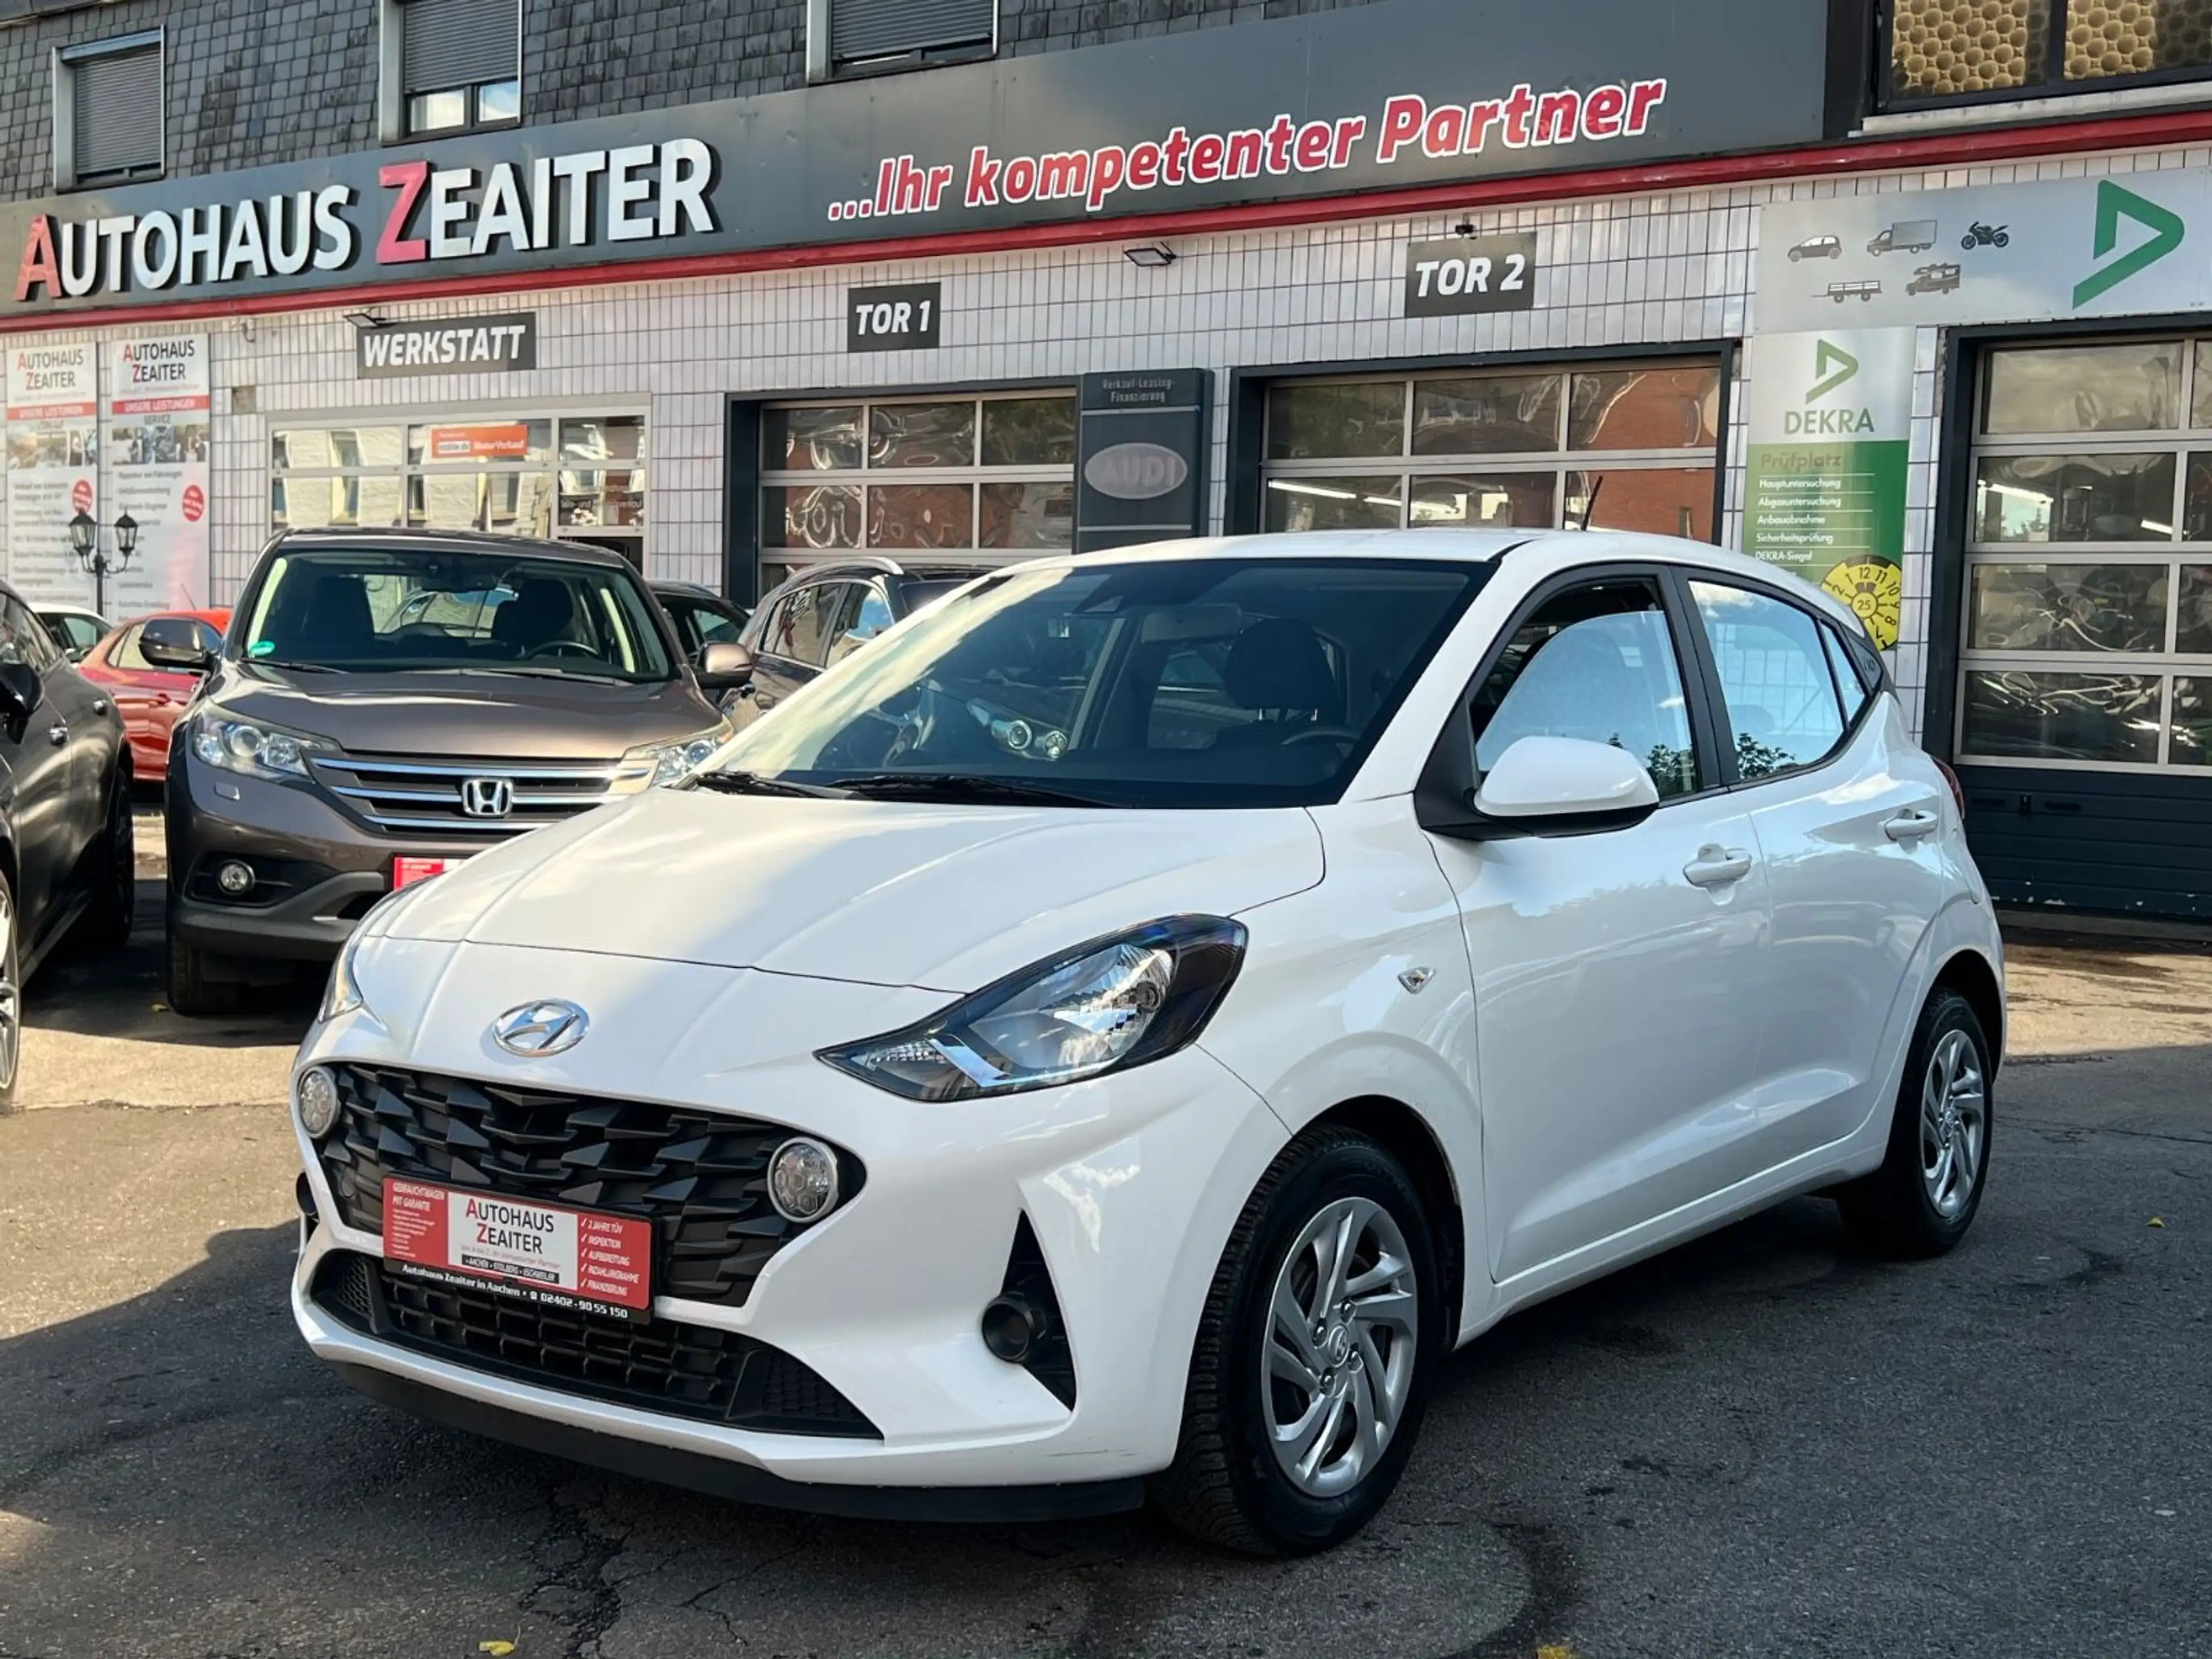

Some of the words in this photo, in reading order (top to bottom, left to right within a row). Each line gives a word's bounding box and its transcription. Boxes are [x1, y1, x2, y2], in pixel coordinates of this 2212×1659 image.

[828, 153, 950, 219] ...Ihr
[964, 113, 1366, 210] kompetenter
[1377, 78, 1666, 164] Partner
[14, 184, 354, 301] AUTOHAUS
[376, 138, 715, 264] ZEAITER
[1415, 257, 1489, 297] TOR
[1499, 253, 1525, 290] 2
[855, 303, 912, 336] TOR
[918, 300, 931, 332] 1
[123, 340, 195, 362] AUTOHAUS
[364, 325, 525, 367] WERKSTATT
[17, 349, 84, 370] AUTOHAUS
[26, 371, 75, 391] ZEAITER
[132, 363, 186, 383] ZEAITER
[1784, 408, 1874, 435] DEKRA
[1101, 454, 1176, 487] AUDI
[1760, 452, 1841, 472] Prüfplatz
[1760, 478, 1841, 491] Hauptuntersuchung
[1758, 496, 1841, 508] Abgasuntersuchung
[1756, 533, 1833, 544] Sicherheitsprüfung
[1859, 567, 1870, 579] 12
[1875, 570, 1888, 584] 11
[1832, 585, 1844, 596] 2
[1886, 581, 1899, 596] 10
[1857, 600, 1870, 611] 25
[1885, 615, 1896, 626] 8
[466, 1198, 554, 1233] AUTOHAUS
[477, 1222, 543, 1255] ZEAITER
[588, 1235, 622, 1249] INSPEKTION
[402, 1264, 444, 1282] Autohaus
[444, 1272, 476, 1288] Zeaiter
[477, 1279, 486, 1289] in
[486, 1281, 521, 1296] Aachen
[594, 1304, 607, 1315] 55
[609, 1306, 628, 1319] 150
